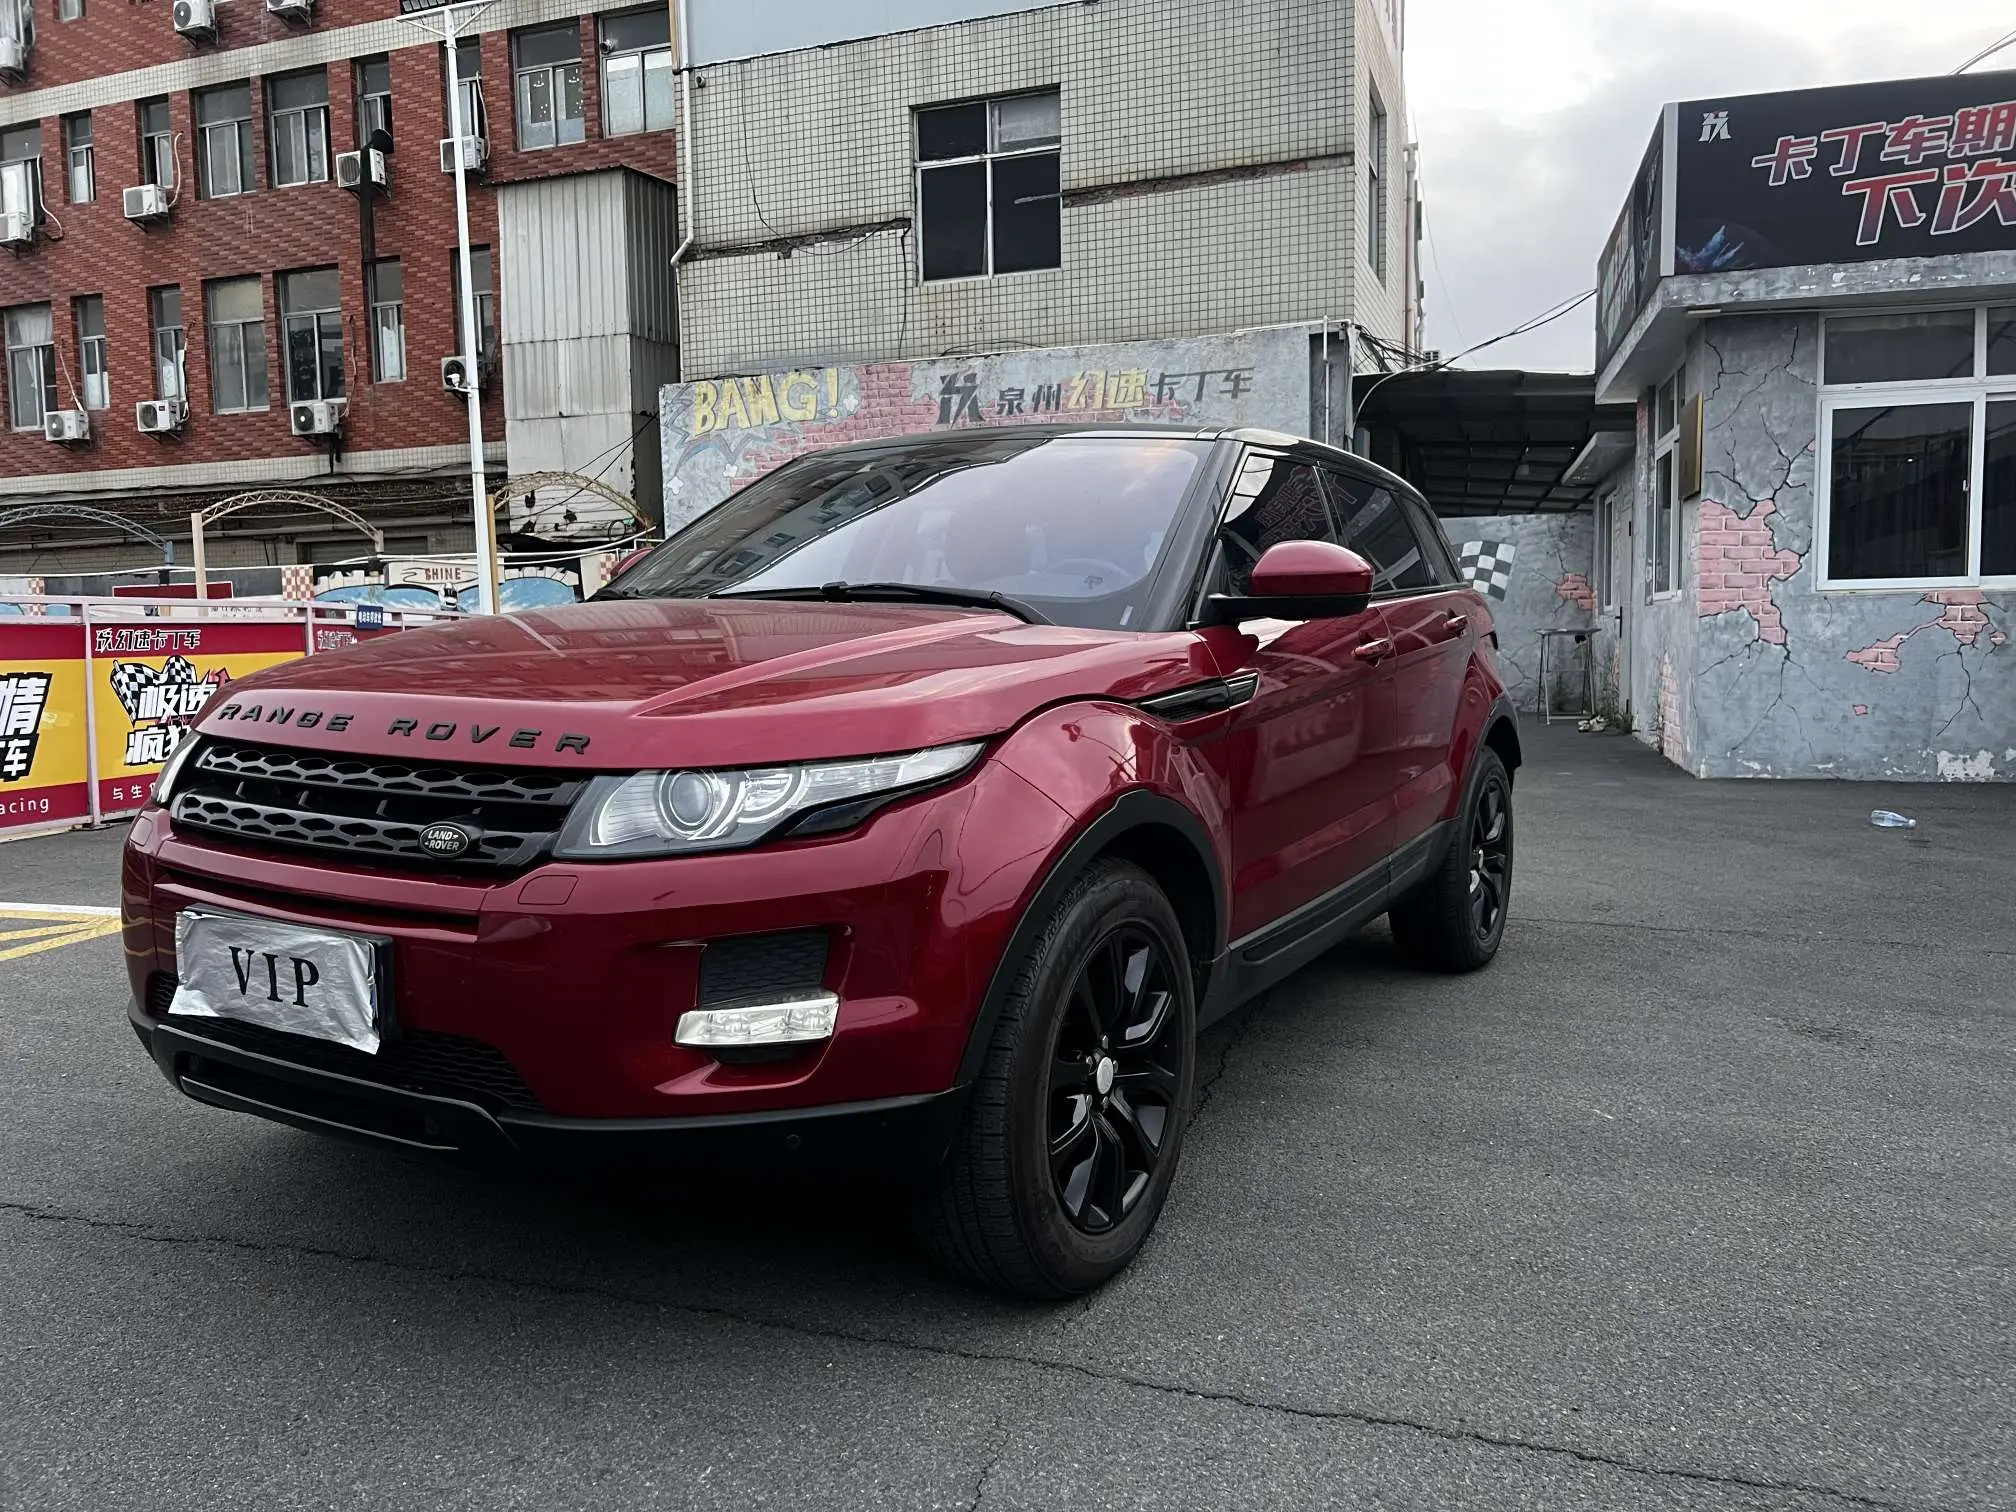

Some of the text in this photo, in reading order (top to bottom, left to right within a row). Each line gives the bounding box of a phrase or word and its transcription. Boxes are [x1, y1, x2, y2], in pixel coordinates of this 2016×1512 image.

[1751, 101, 2016, 186] 卡丁车期
[999, 367, 1255, 415] 泉州幻速卡丁车
[425, 568, 462, 581] SHINE
[115, 629, 201, 651] 幻速卡丁车
[216, 704, 591, 754] RANGE ROVER
[0, 739, 31, 776] 车
[113, 782, 156, 800] 与生
[228, 945, 320, 1008] VIP
